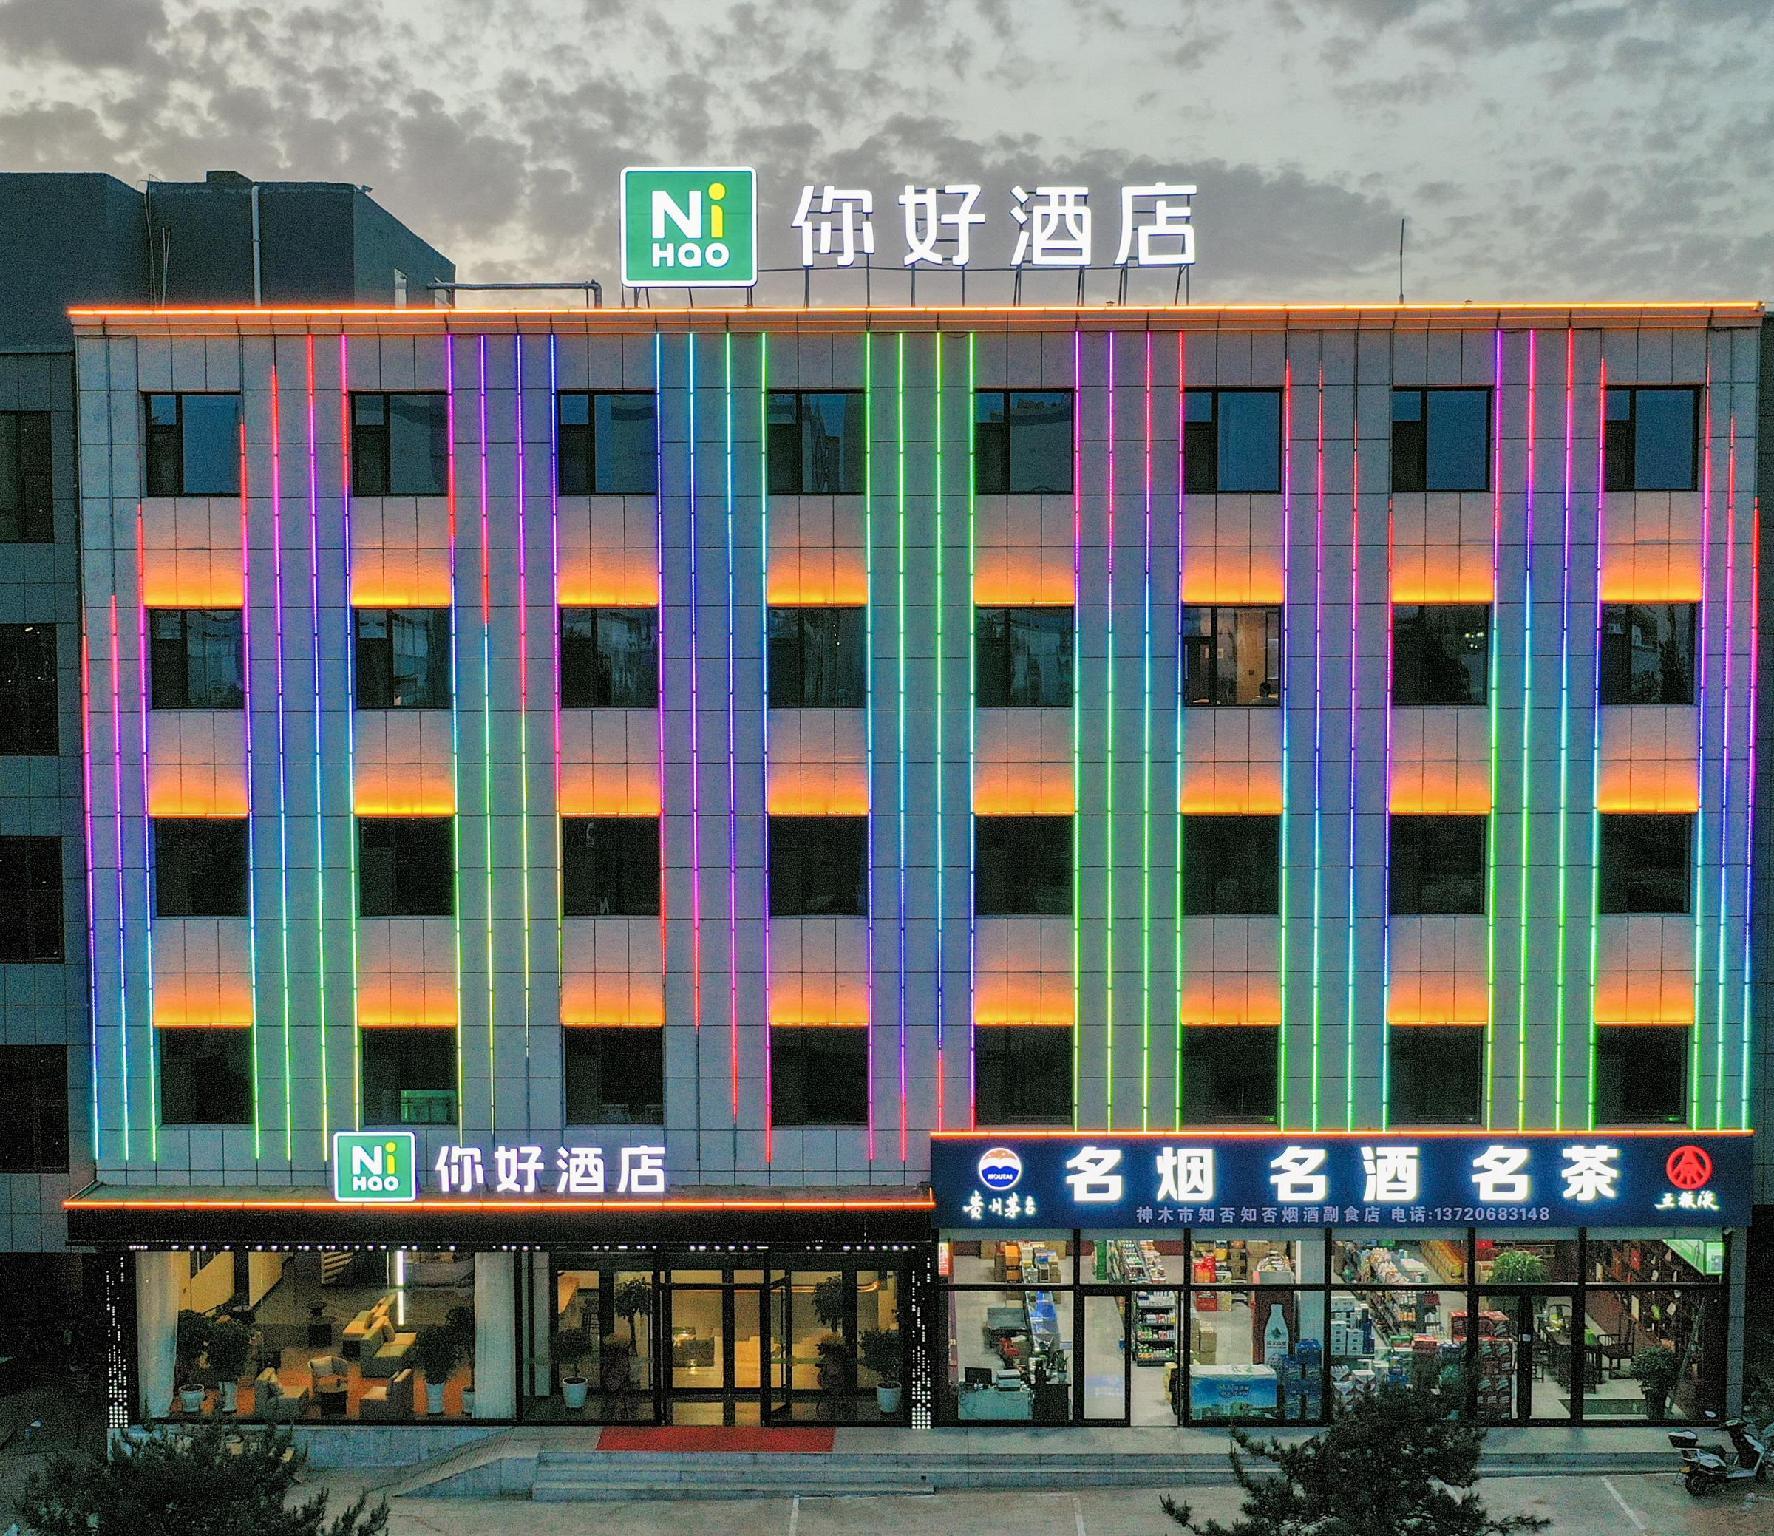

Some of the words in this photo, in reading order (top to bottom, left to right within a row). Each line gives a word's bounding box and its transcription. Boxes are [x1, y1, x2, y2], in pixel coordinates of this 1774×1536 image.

[652, 182, 727, 239] Ni
[791, 182, 1198, 267] 你好酒店
[352, 1141, 397, 1177] Ni
[434, 1144, 667, 1194] 你好酒店
[1136, 1205, 1381, 1224] 神木市知否知否烟酒副食店
